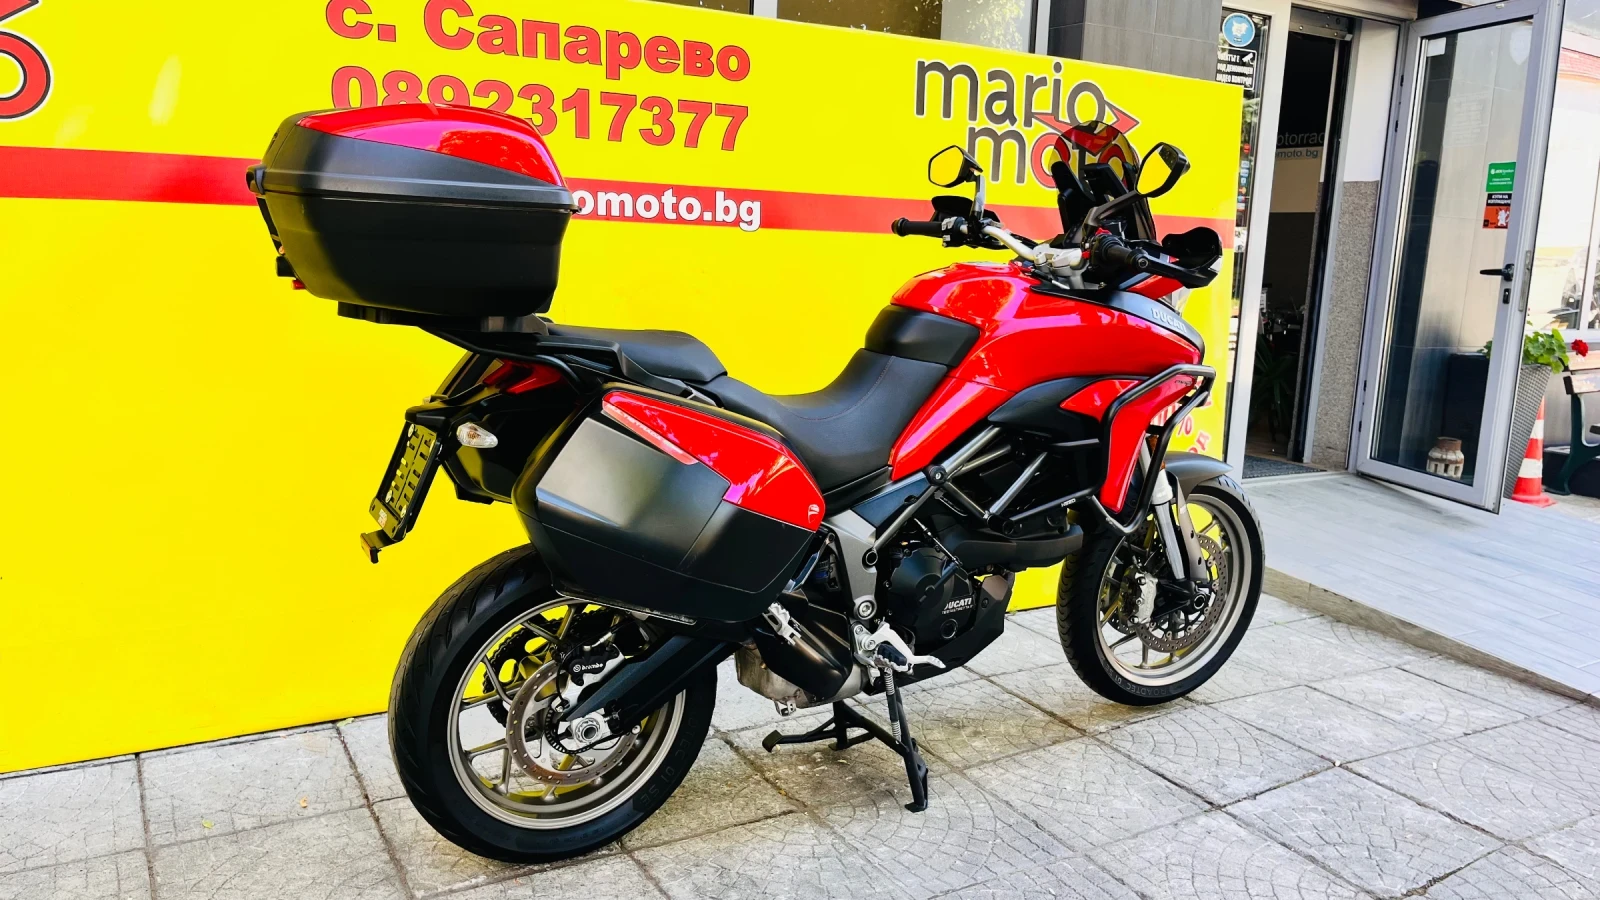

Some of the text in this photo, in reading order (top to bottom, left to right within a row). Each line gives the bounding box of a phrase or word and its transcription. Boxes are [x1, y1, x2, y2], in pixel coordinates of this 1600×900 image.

[424, 0, 750, 81] Сапарево
[331, 66, 749, 151] 0892317377
[915, 60, 1106, 127] mario
[1151, 307, 1187, 333] DUCATI
[582, 662, 604, 671] brembo
